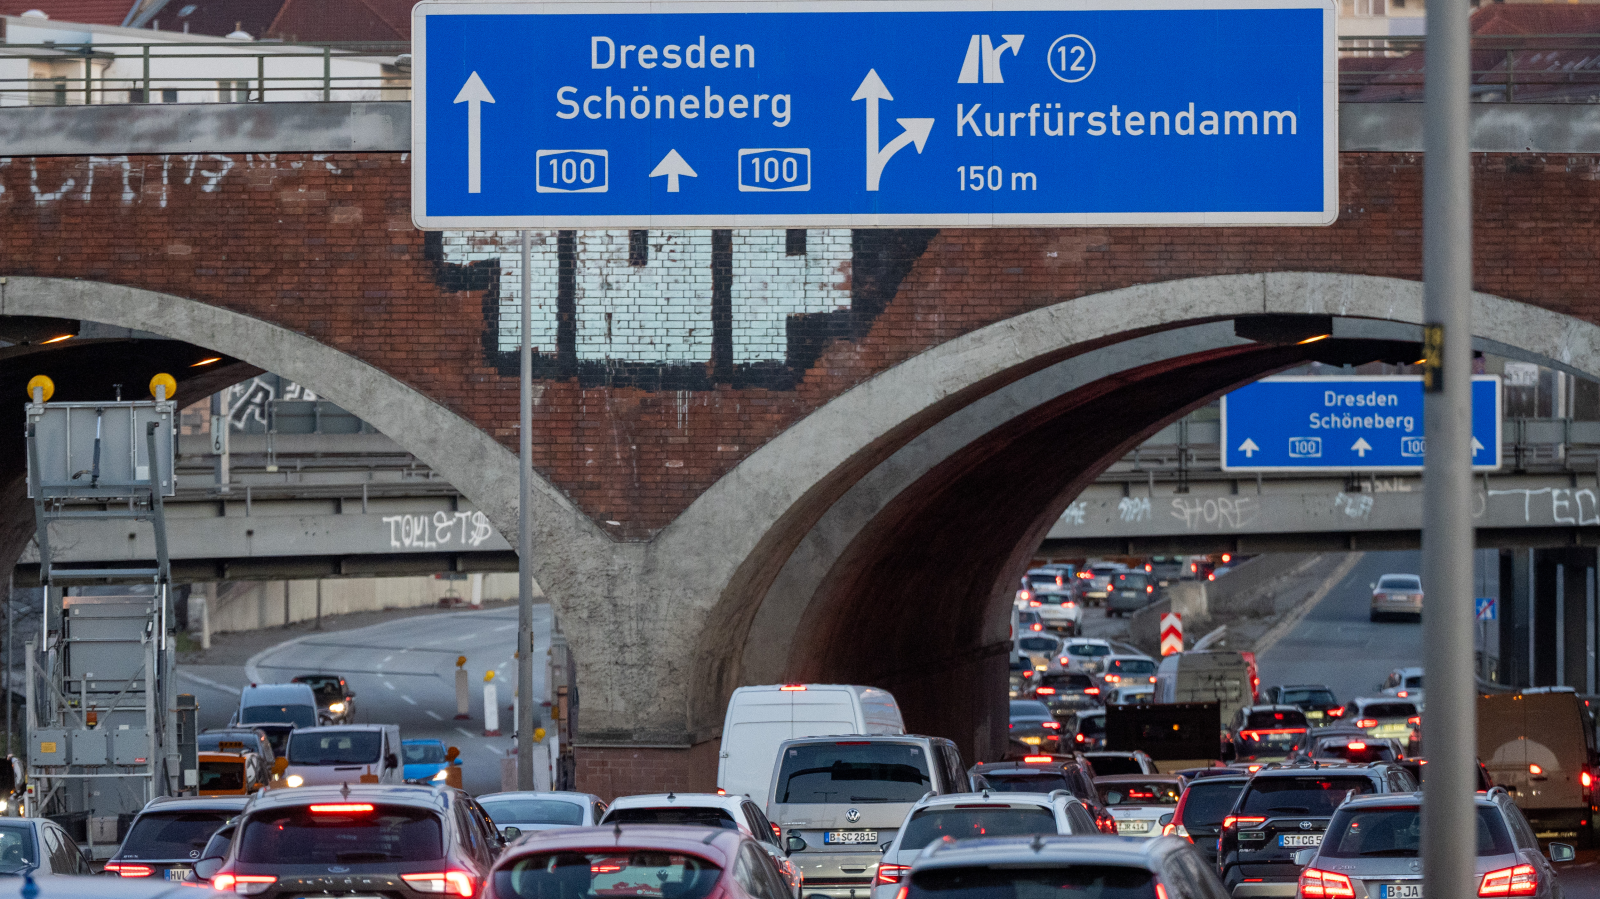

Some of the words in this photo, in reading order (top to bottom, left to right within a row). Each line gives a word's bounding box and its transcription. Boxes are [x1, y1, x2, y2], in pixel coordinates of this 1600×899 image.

[590, 35, 756, 69] Dresden
[1056, 45, 1086, 72] 12
[555, 85, 792, 128] Schöneberg
[956, 102, 1297, 137] Kurfürstendamm
[549, 158, 595, 184] 100
[751, 157, 798, 183] 100
[956, 166, 1002, 192] 150
[1011, 170, 1037, 191] m
[1324, 390, 1398, 407] Dresden
[1309, 411, 1414, 433] Schöneberg
[1294, 440, 1316, 454] 100
[1170, 497, 1250, 529] SHORE
[830, 833, 836, 841] B
[841, 833, 853, 841] SC
[854, 833, 877, 841] 2815
[1284, 835, 1296, 845] ST
[1301, 835, 1314, 845] CG
[1387, 886, 1395, 897] B
[1403, 886, 1419, 897] JA
